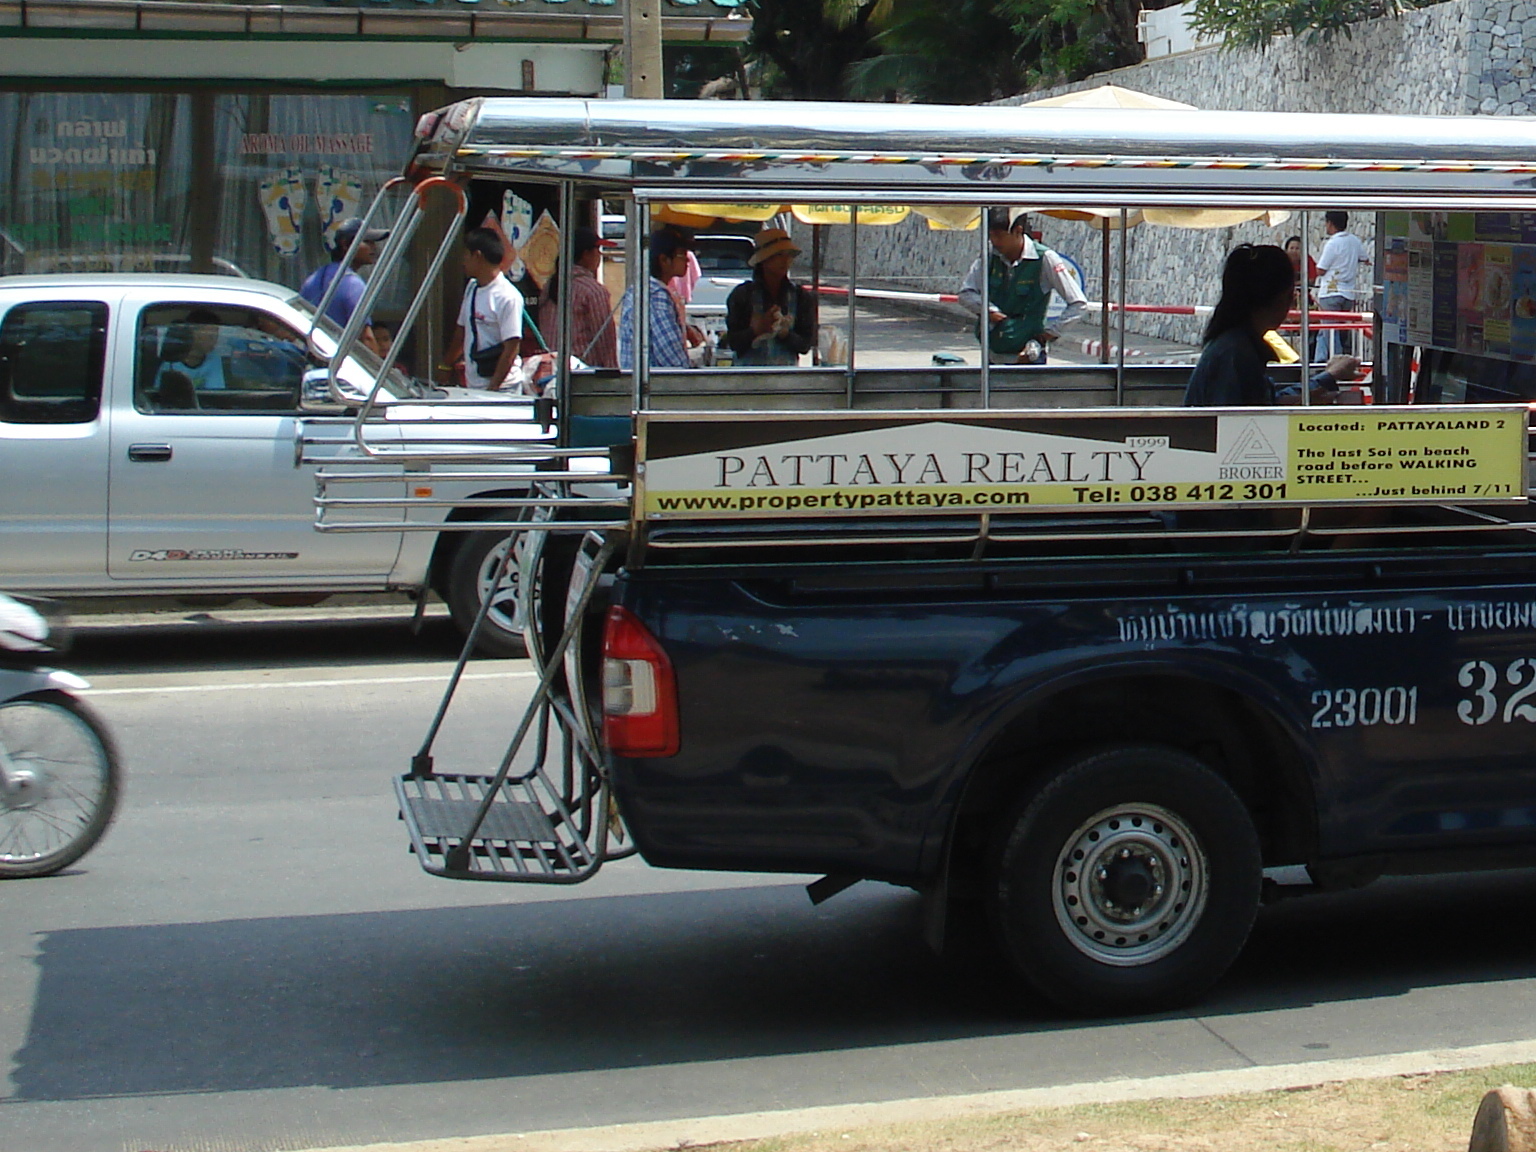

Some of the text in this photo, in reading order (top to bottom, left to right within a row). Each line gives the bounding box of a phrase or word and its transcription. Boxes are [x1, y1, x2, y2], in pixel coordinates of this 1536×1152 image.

[241, 134, 374, 153] AROMA OIL MASSAGE
[1298, 420, 1506, 433] Located: PATTAYALAND 2
[1128, 437, 1168, 448] 1999
[1297, 445, 1470, 458] The last Soi on beach
[715, 450, 1156, 488] PATTAYA REALTY
[1297, 458, 1478, 472] road before WALKING
[1218, 465, 1285, 481] BROKER
[1297, 474, 1369, 485] STREET...
[1356, 483, 1512, 497] ...Just behind 7/11
[657, 483, 1288, 512] www.propertypattaya.com Tel: 038 412 301
[1311, 685, 1418, 728] 23001
